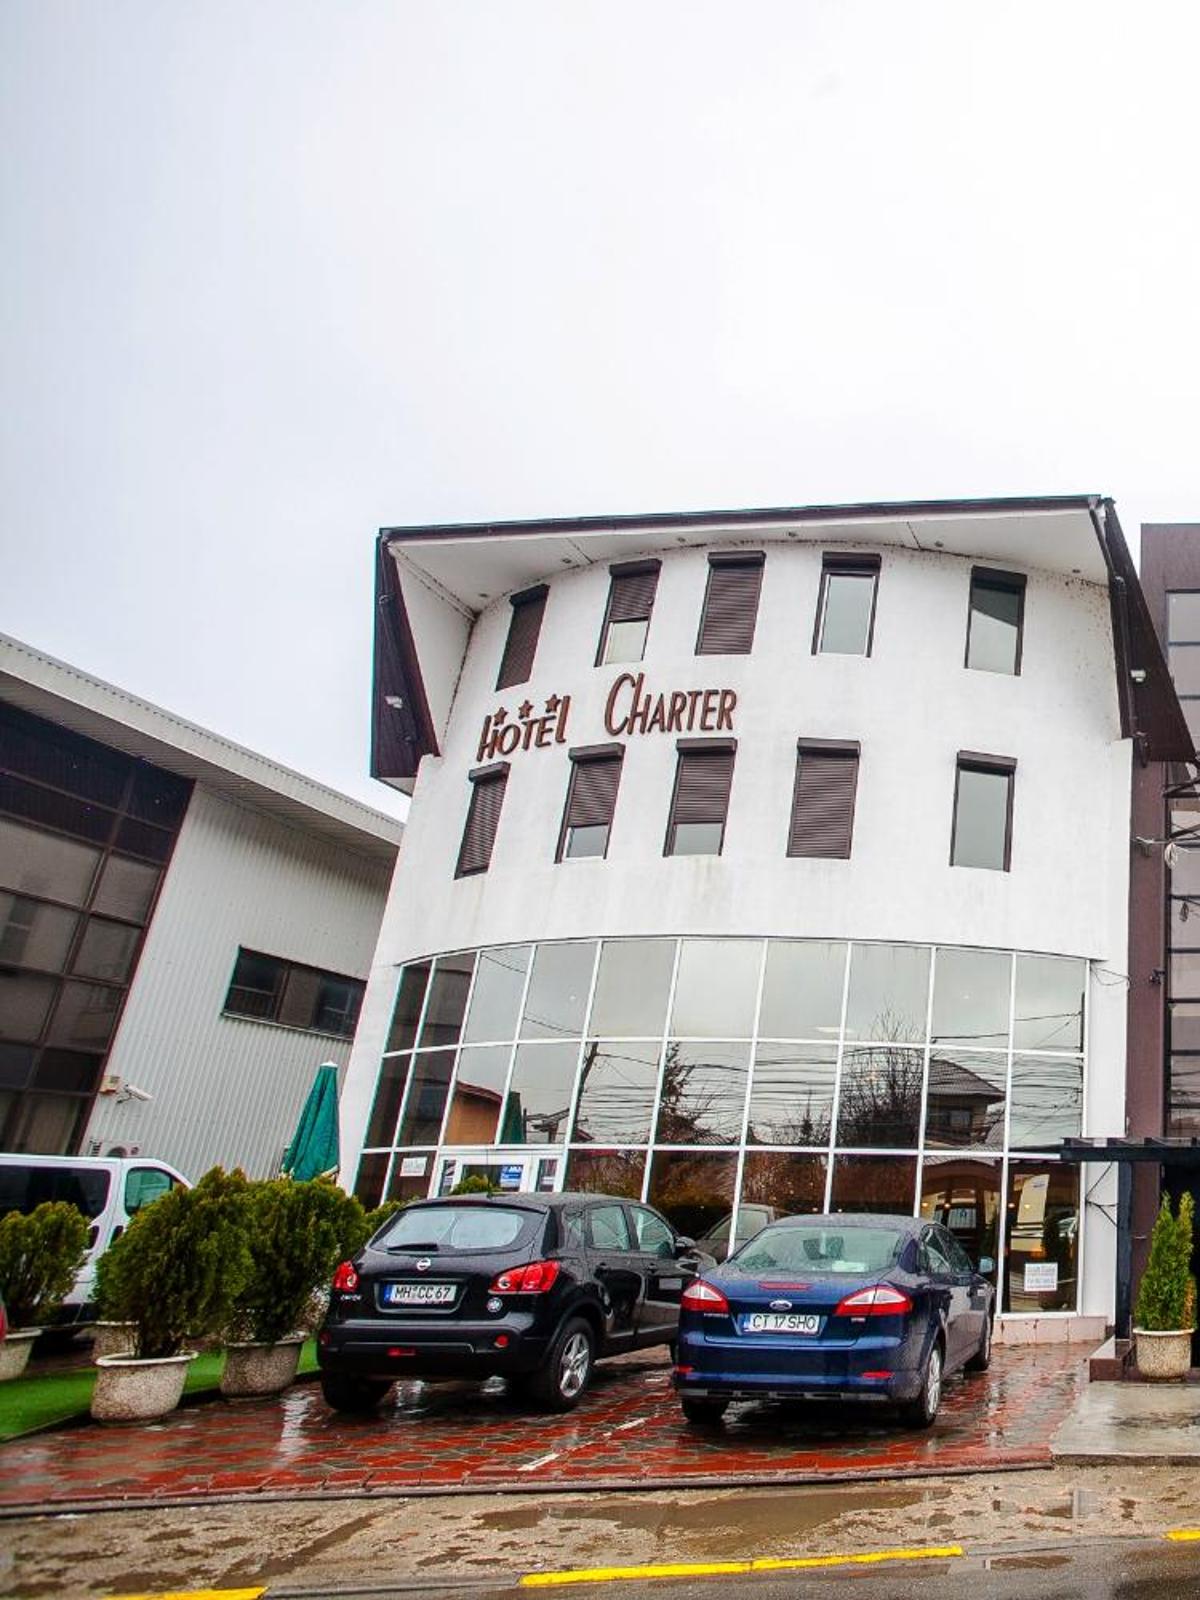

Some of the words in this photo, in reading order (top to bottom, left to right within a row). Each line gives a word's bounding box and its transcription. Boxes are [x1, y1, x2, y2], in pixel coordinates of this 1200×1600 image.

[604, 672, 738, 736] CHARTER
[436, 1285, 451, 1298] 67
[753, 1314, 770, 1329] CT
[774, 1314, 786, 1329] 17
